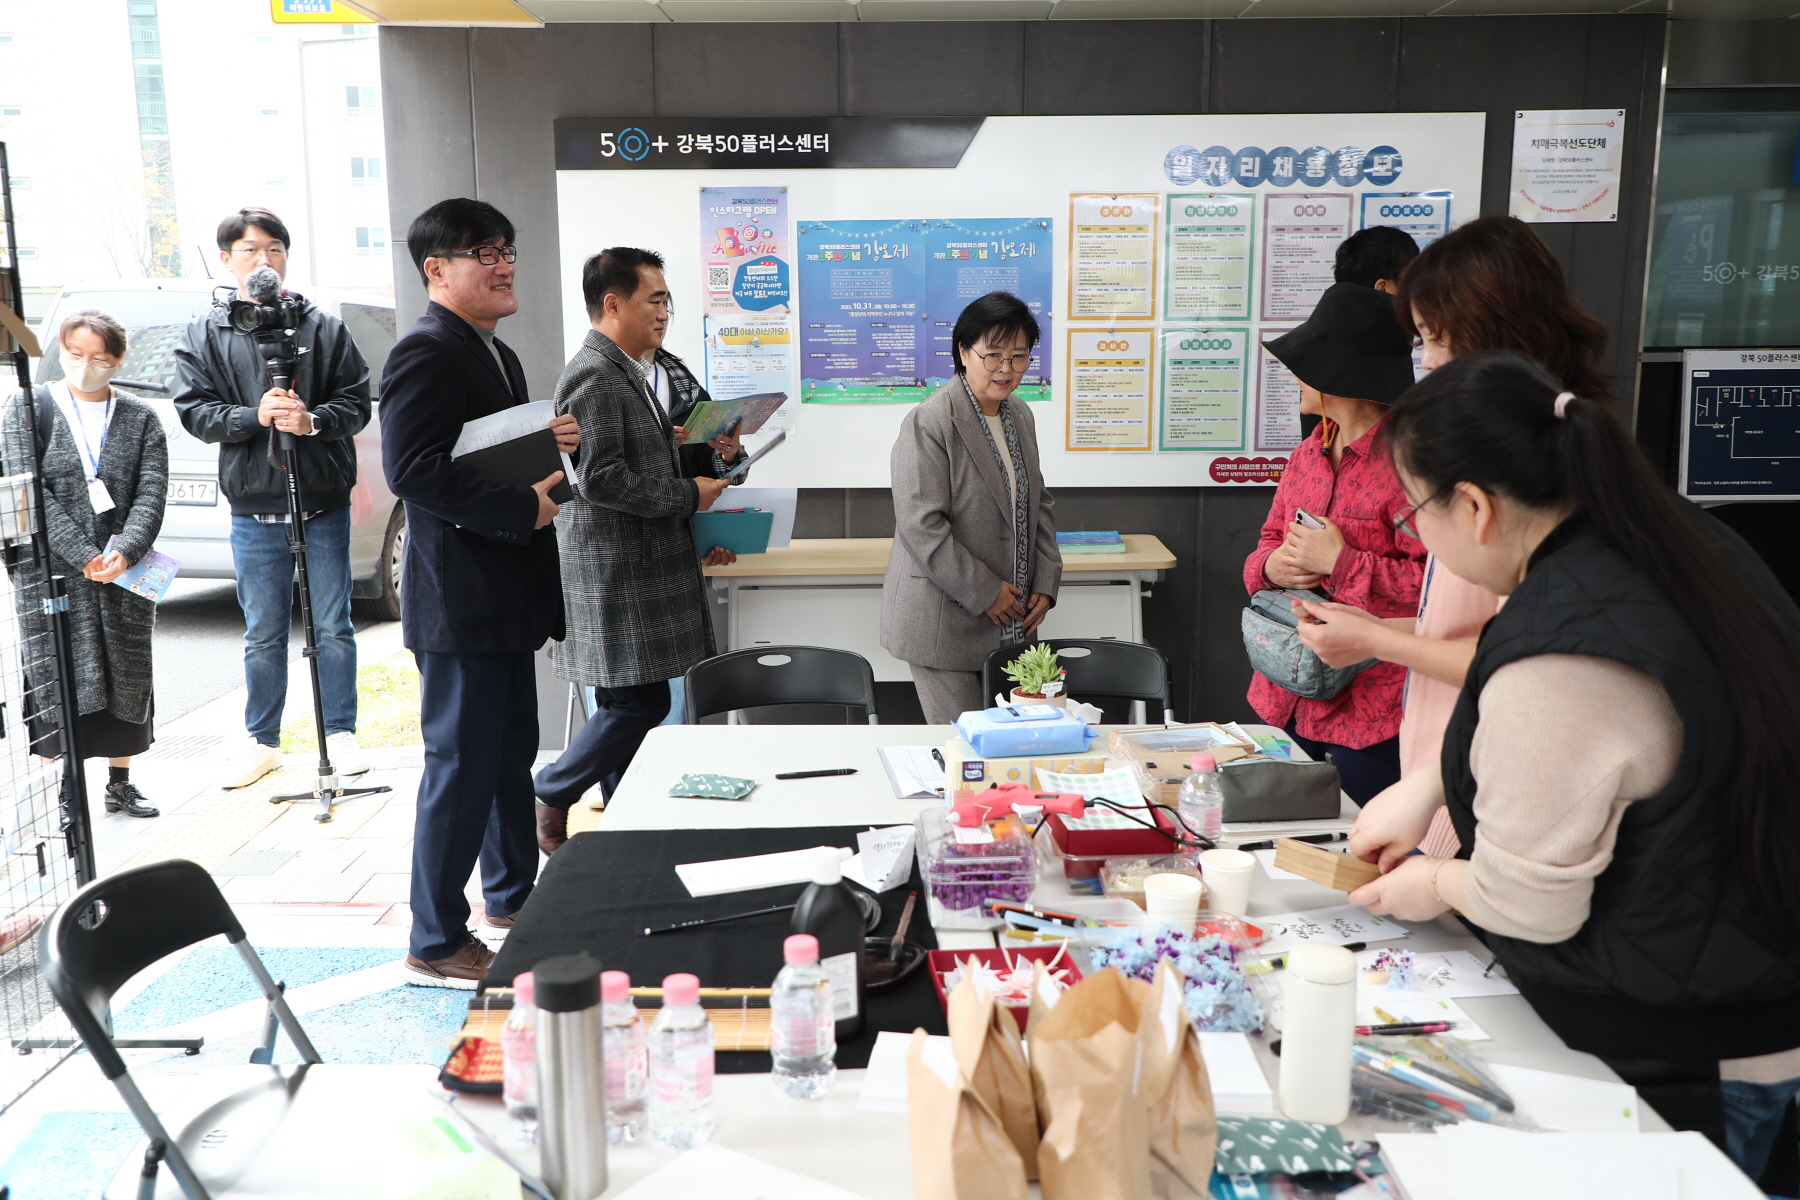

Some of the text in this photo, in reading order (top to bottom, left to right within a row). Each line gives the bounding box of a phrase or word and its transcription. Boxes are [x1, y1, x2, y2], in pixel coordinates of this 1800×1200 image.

[677, 134, 830, 153] 강북50플러스센터
[1531, 138, 1607, 149] 치매극복선도단체
[710, 206, 777, 218] 인스타그램 OPEN
[843, 251, 861, 261] 기념
[970, 249, 988, 259] 기념
[718, 327, 789, 337] 40대 이상 이신가요?
[1740, 354, 1756, 363] 강북
[168, 482, 207, 498] 0617
